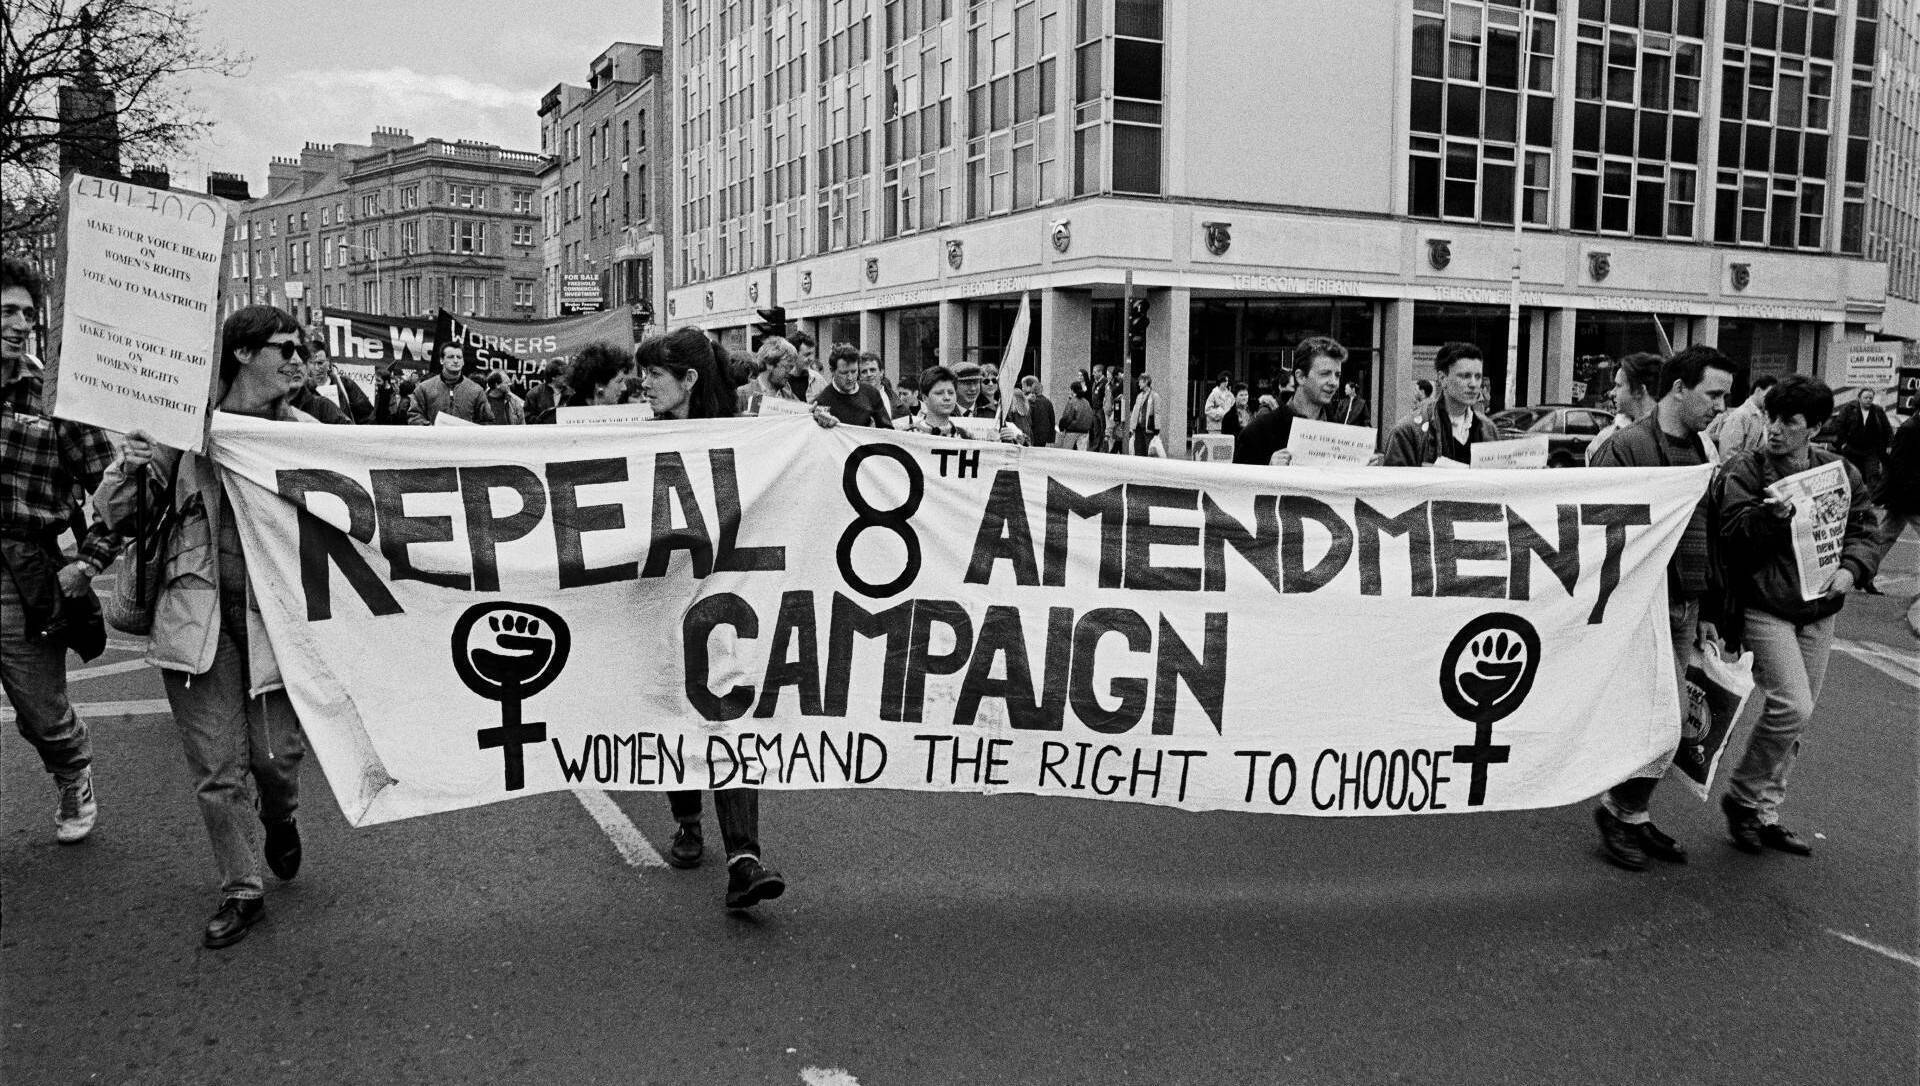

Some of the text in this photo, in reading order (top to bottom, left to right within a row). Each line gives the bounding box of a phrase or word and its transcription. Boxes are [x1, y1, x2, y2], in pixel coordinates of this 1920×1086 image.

[86, 218, 217, 264] MAKE YOUR VOICE HEARD
[140, 247, 156, 259] ON
[105, 249, 191, 282] WOMEN'S RIGHTS
[82, 268, 208, 313] VOTE NO TO MAASTRICHT
[79, 323, 206, 367] MAKE YOUR VOICE HEARD
[128, 351, 143, 363] ON
[324, 316, 384, 359] The
[451, 319, 557, 353] WORKERS
[96, 353, 180, 385] WOMEN'S RIGHTS
[73, 371, 198, 415] VOTE NO TO MAASTRICHT
[276, 448, 786, 622] REPEAL
[964, 470, 1651, 625] AMENDMENT
[683, 590, 1228, 736] CAMPAIGN
[552, 731, 1453, 811] WOMEN DEMAND THE RIGHT TO CHOOSE
